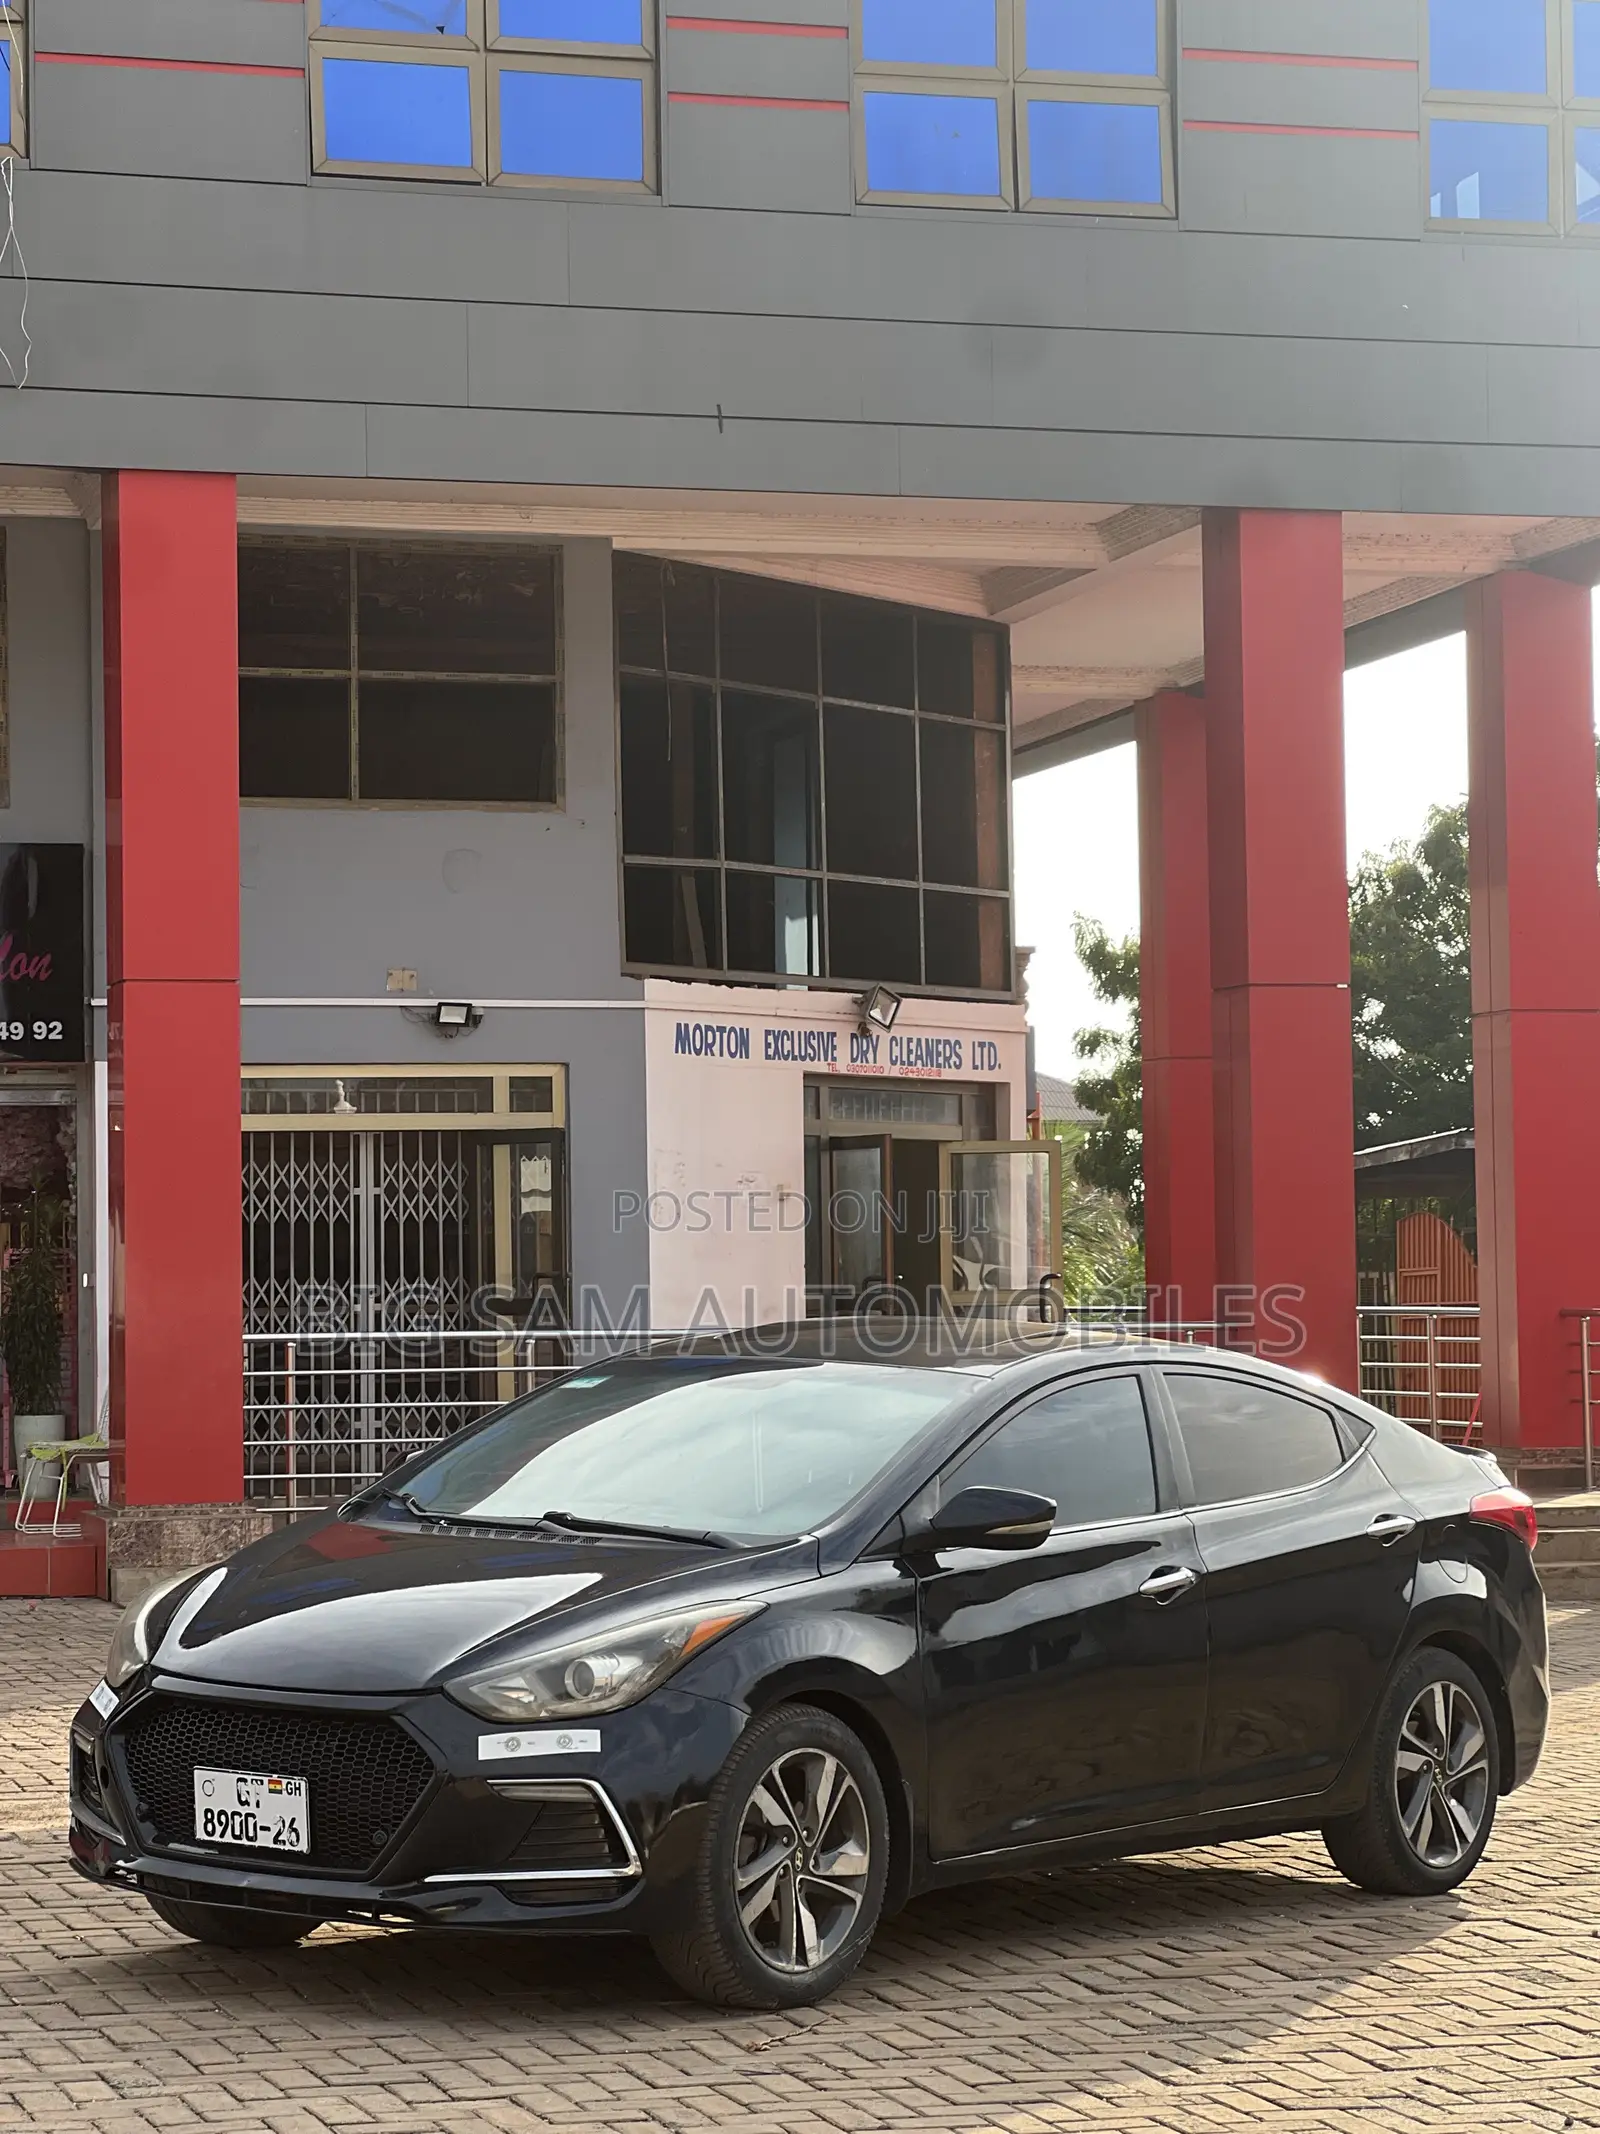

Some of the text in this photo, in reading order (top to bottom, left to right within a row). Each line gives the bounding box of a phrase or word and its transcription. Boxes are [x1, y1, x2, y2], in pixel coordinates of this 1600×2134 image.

[33, 1021, 63, 1040] 92
[674, 1022, 1002, 1071] MORTON EXCLUSIVE DRY CLEANERS LTD.
[285, 1781, 302, 1797] GH
[203, 1808, 300, 1847] 8900-26
